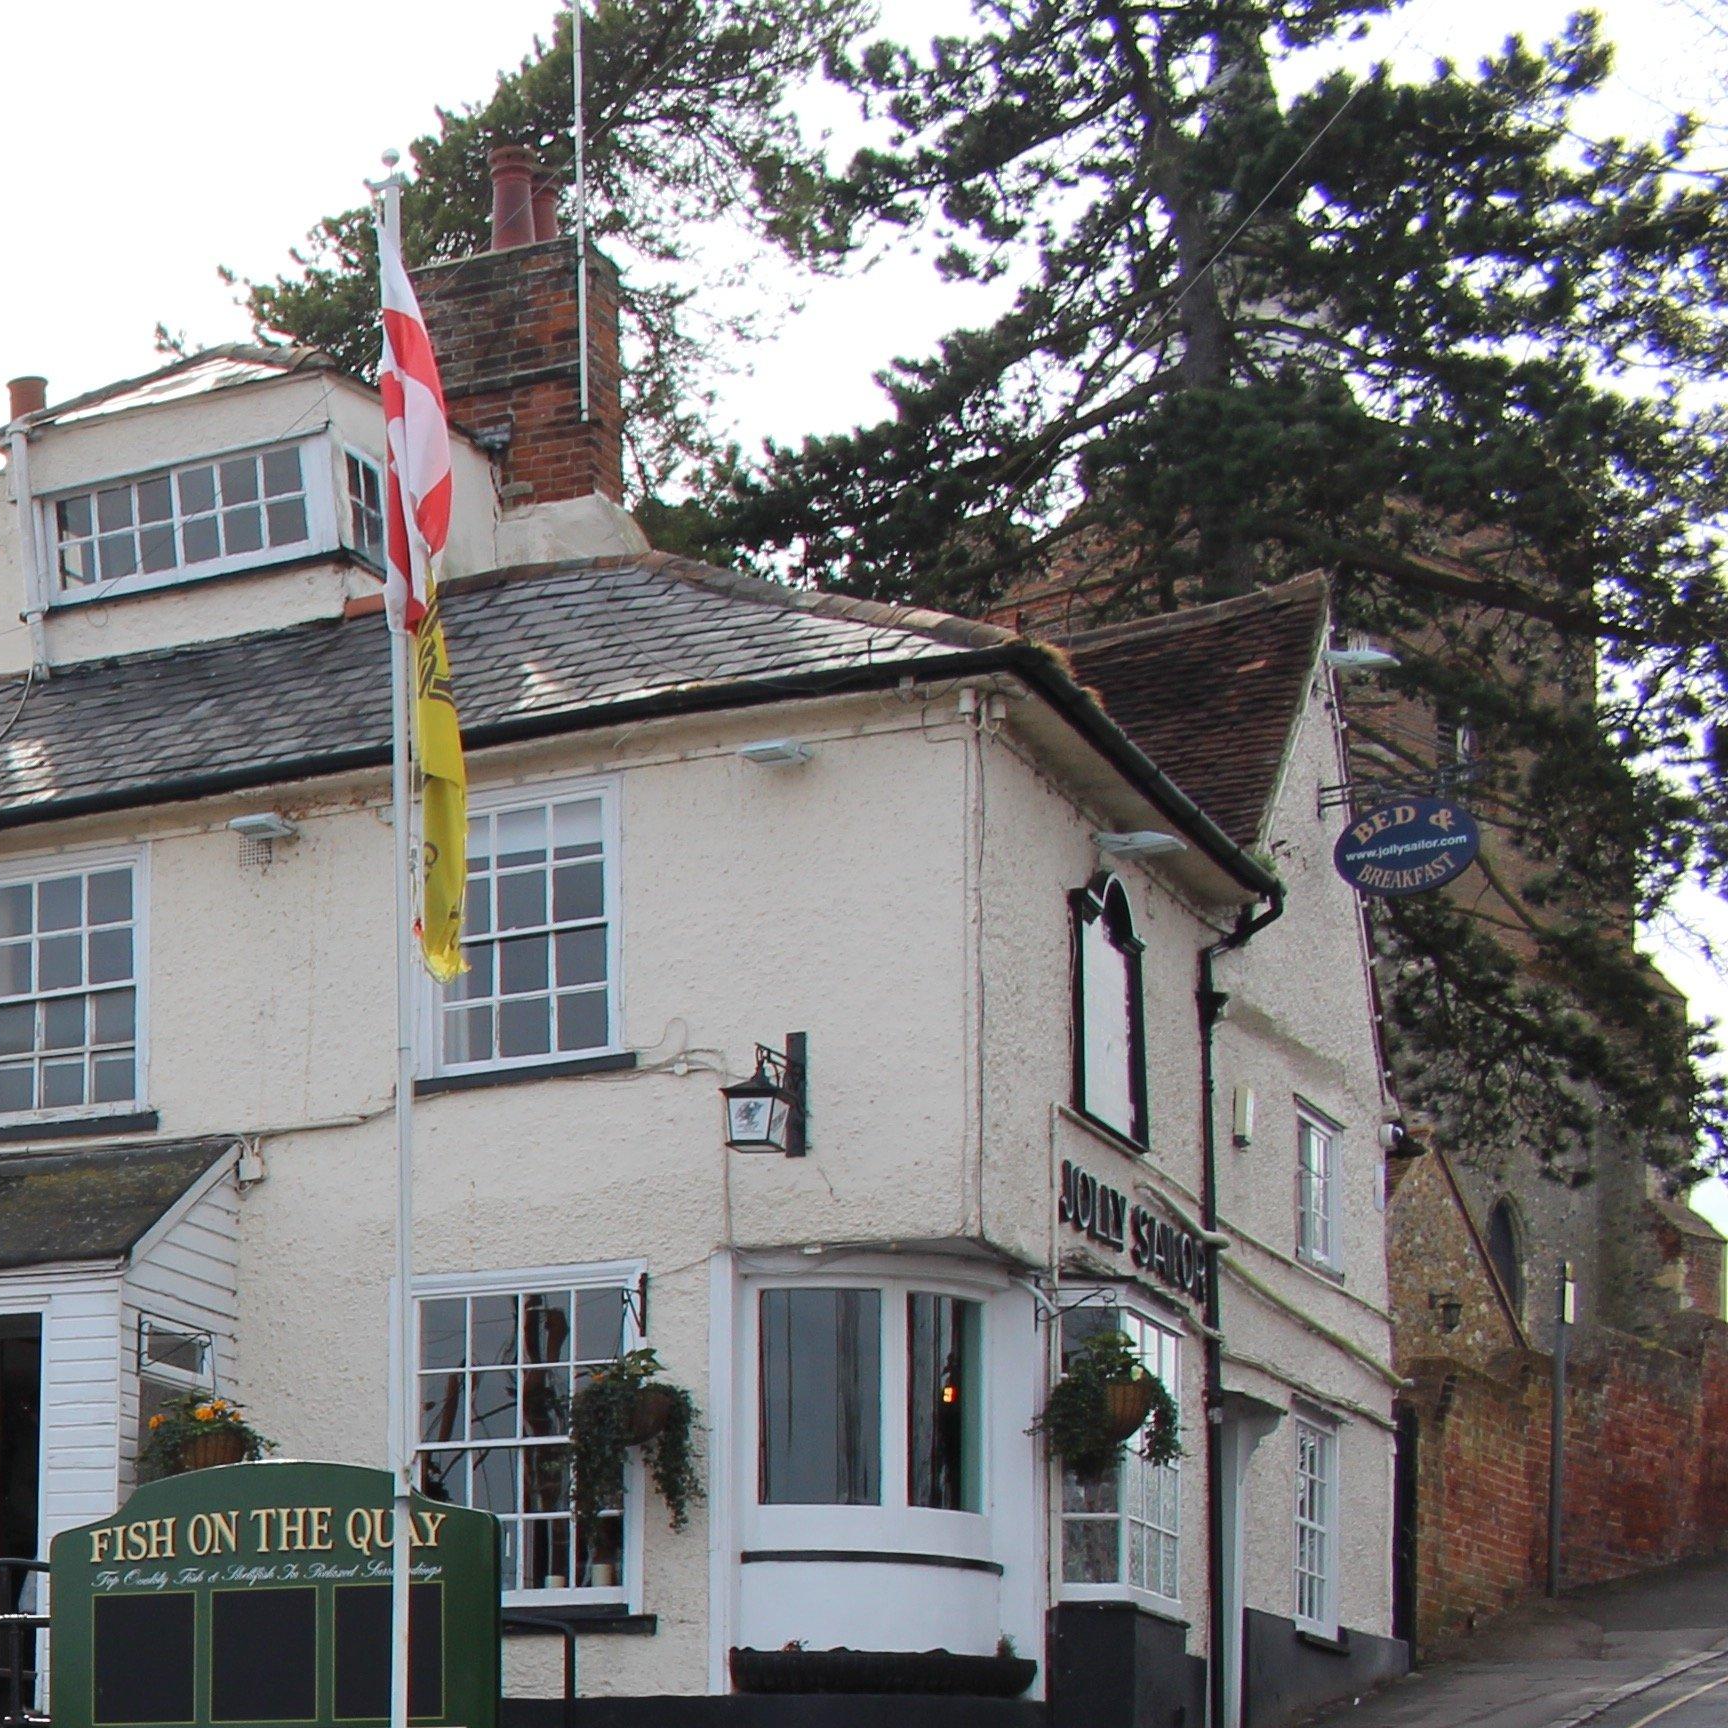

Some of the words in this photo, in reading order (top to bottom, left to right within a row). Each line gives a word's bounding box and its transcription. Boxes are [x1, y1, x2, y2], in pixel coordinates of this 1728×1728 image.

[1351, 805, 1418, 845] BED
[1429, 808, 1455, 831] &
[1345, 835, 1467, 861] www.jollysailor.com
[1356, 851, 1456, 888] BREAKFAST
[1059, 1159, 1126, 1253] JOLLY
[89, 1517, 176, 1563] FISH
[187, 1510, 239, 1556] ON
[249, 1507, 332, 1553] THE
[346, 1508, 446, 1556] QUAY
[91, 1570, 120, 1592] Top
[123, 1568, 170, 1591] Quality
[173, 1567, 206, 1585] Fish
[221, 1564, 277, 1587] Shellfish
